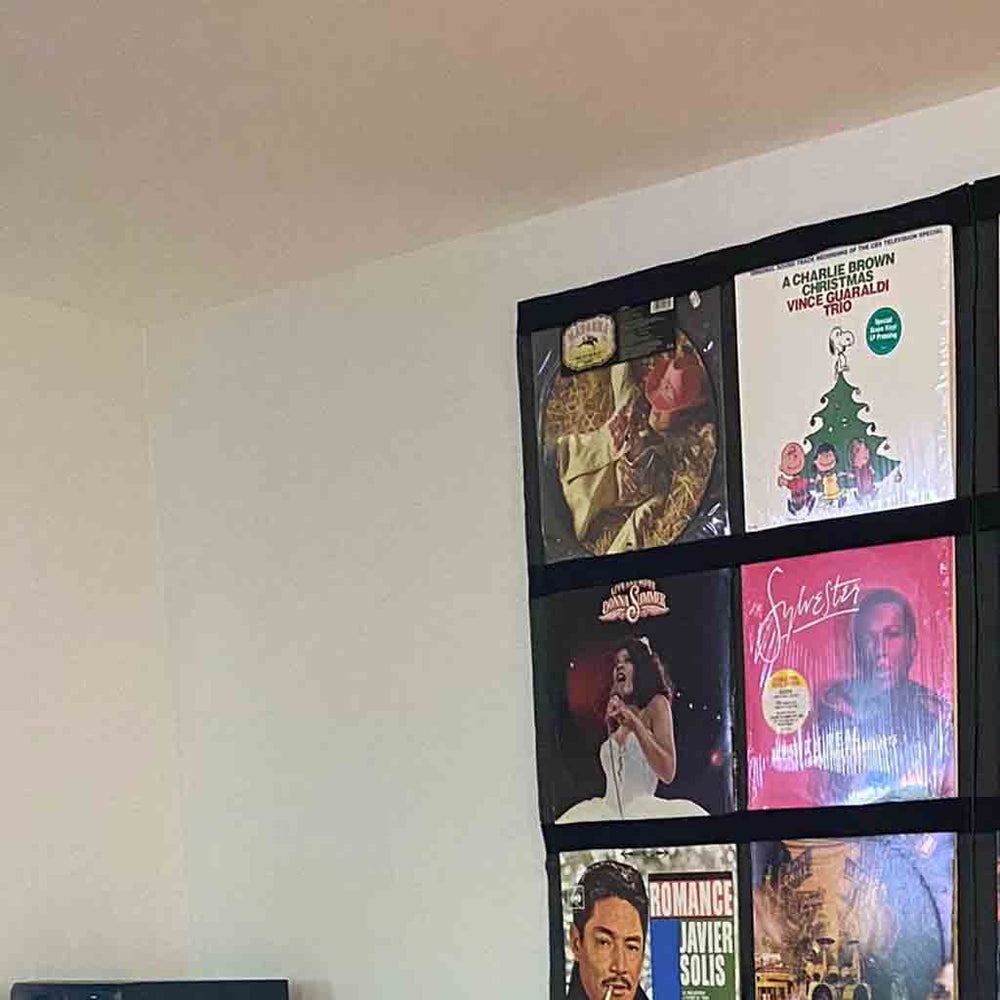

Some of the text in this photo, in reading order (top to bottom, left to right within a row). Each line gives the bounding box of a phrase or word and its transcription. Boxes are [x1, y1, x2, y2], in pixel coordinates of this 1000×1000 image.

[782, 276, 791, 289] A
[792, 263, 845, 284] CHARLIE
[848, 252, 896, 274] BROWN
[801, 270, 874, 297] CHRISTMAS
[787, 279, 889, 312] VINCE GUARALDI
[823, 300, 853, 317] TRIO
[754, 566, 861, 670] Sylvester
[650, 880, 733, 917] ROMANCE
[680, 921, 733, 953] JAVIER
[679, 954, 726, 986] SOLIS
